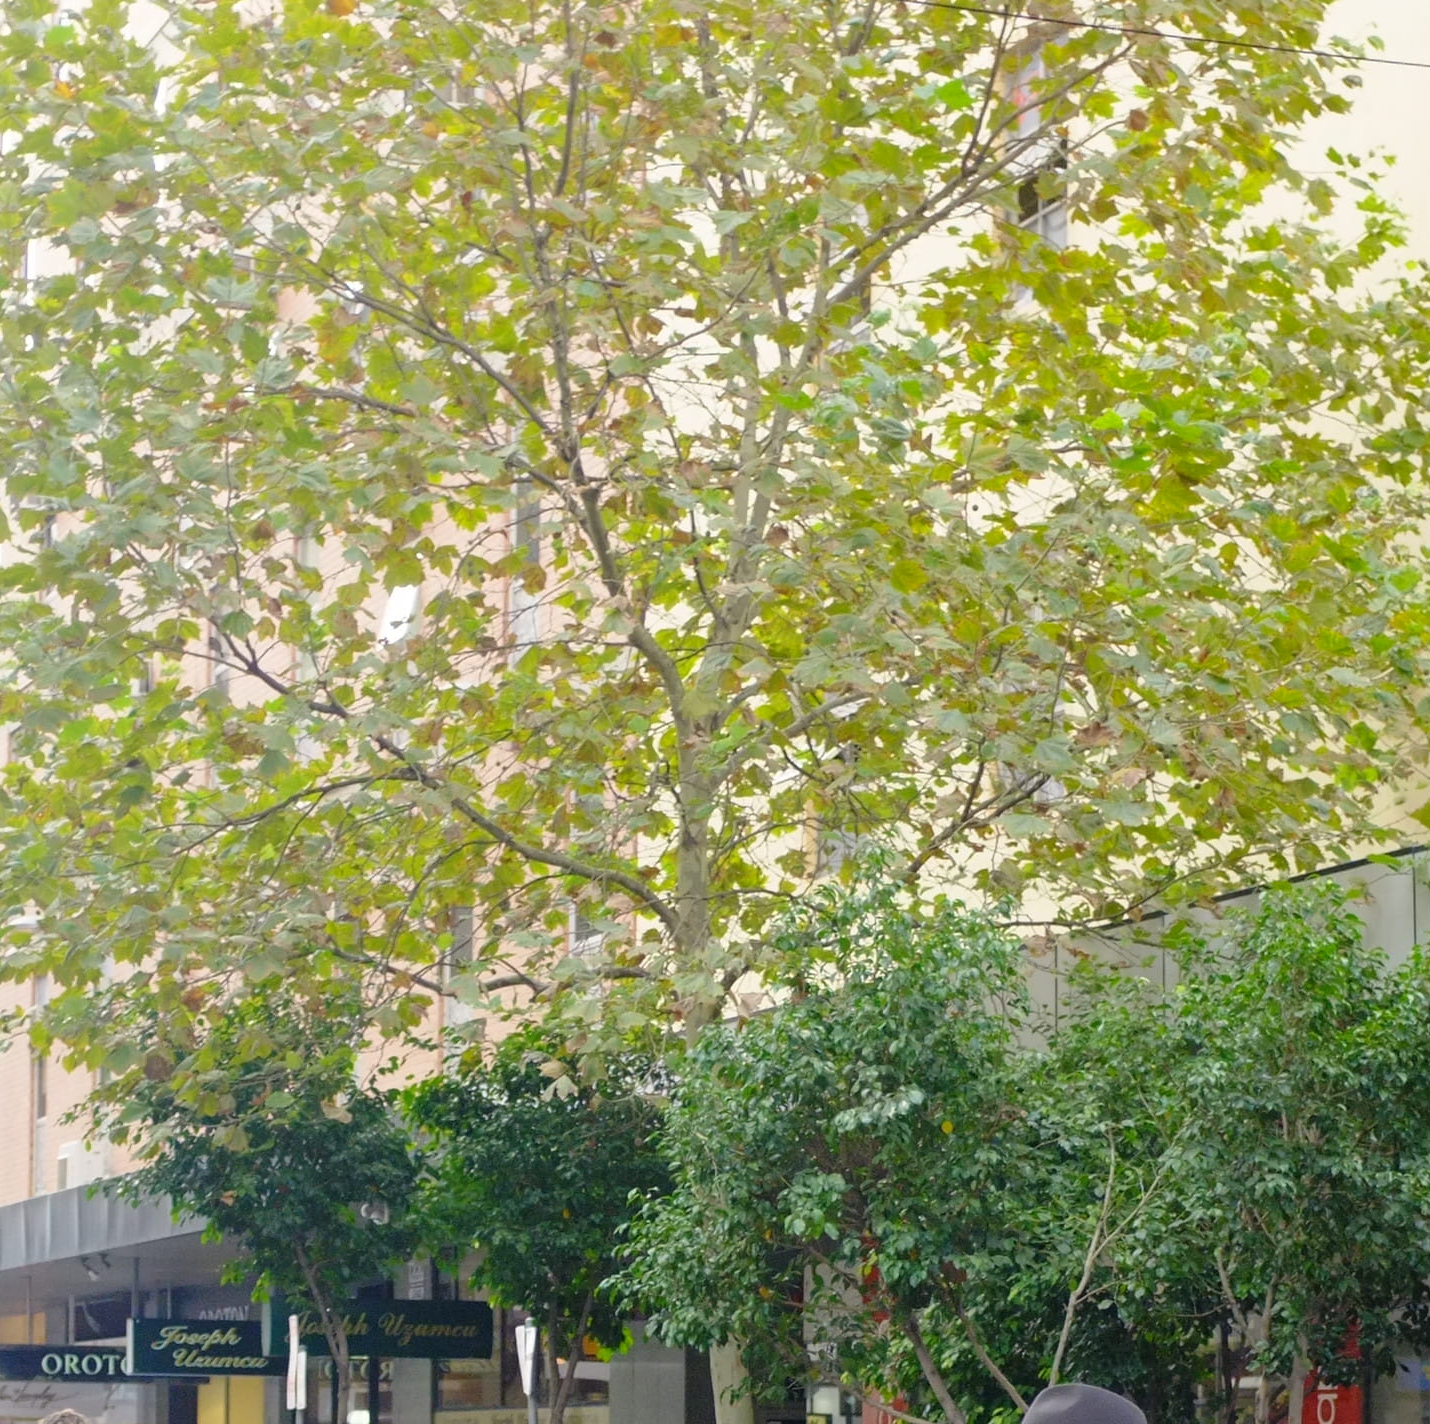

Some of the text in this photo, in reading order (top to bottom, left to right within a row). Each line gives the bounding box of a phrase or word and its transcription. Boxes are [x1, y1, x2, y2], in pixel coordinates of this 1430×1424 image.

[151, 1326, 243, 1350] Joseph
[377, 1312, 478, 1346] Uzumcu
[171, 1349, 269, 1369] Uzumcu
